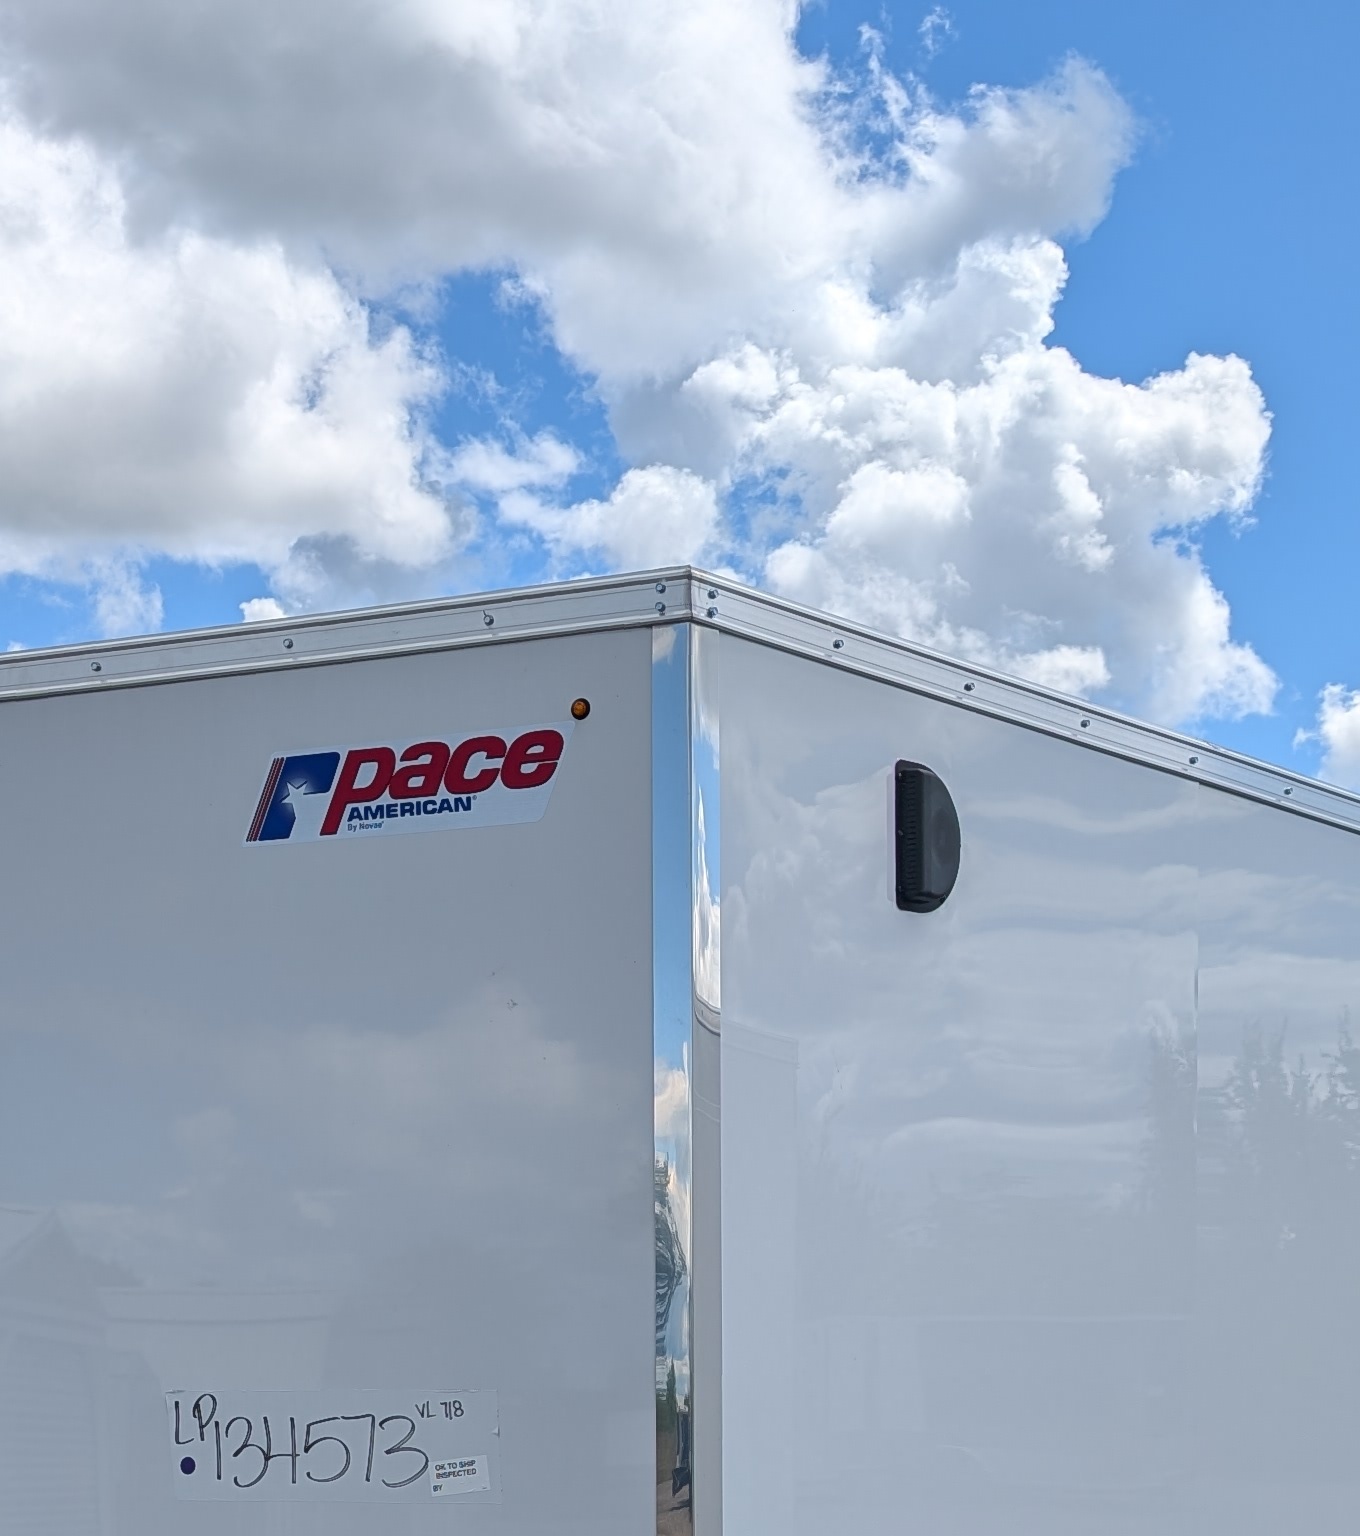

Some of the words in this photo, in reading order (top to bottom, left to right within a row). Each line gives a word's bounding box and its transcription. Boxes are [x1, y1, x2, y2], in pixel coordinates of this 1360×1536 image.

[319, 729, 565, 836] pace
[347, 796, 472, 822] AMERICAN
[347, 823, 358, 833] By
[447, 1462, 458, 1470] TO
